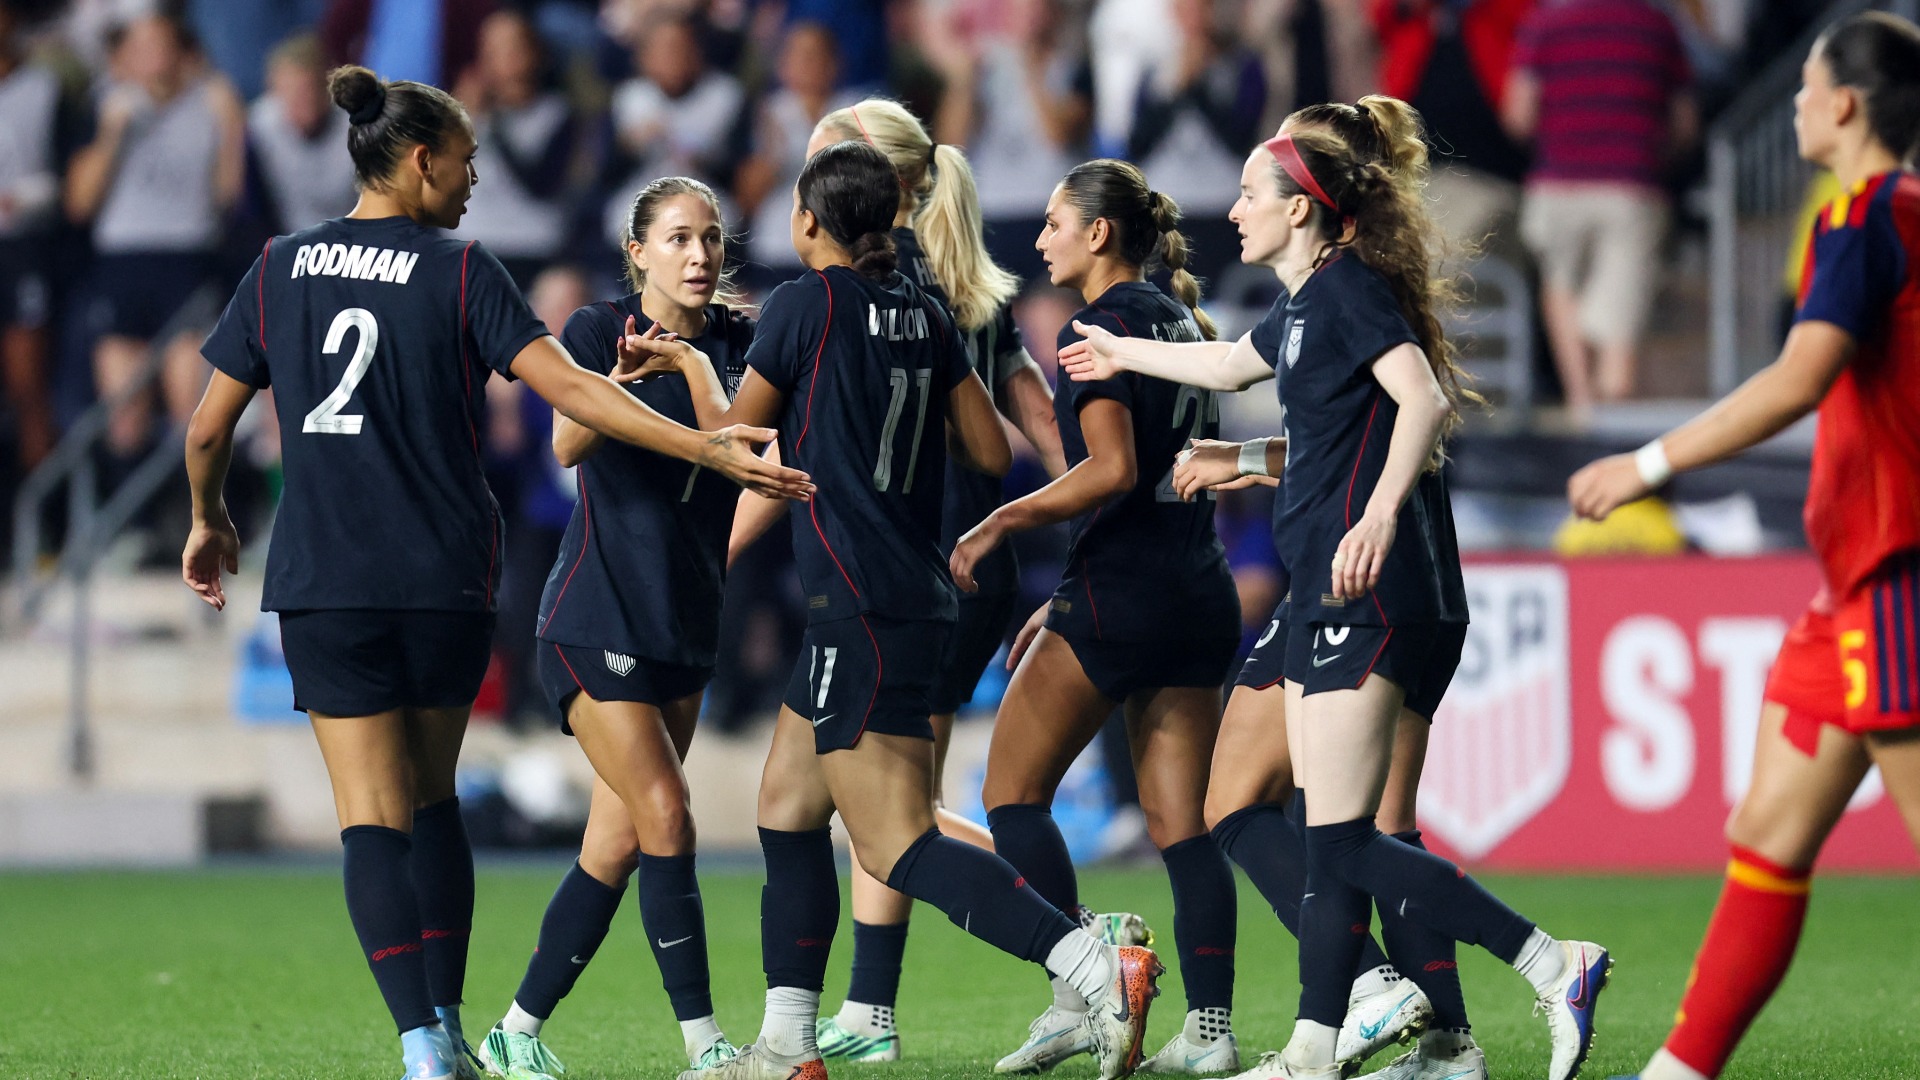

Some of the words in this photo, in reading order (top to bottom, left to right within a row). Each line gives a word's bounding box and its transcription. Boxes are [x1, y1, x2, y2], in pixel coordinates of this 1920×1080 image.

[291, 242, 420, 285] RODMAN
[302, 307, 379, 435] 2
[873, 367, 931, 494] 11
[809, 645, 838, 708] 11
[1456, 588, 1548, 686] SA
[1839, 629, 1867, 710] 5
